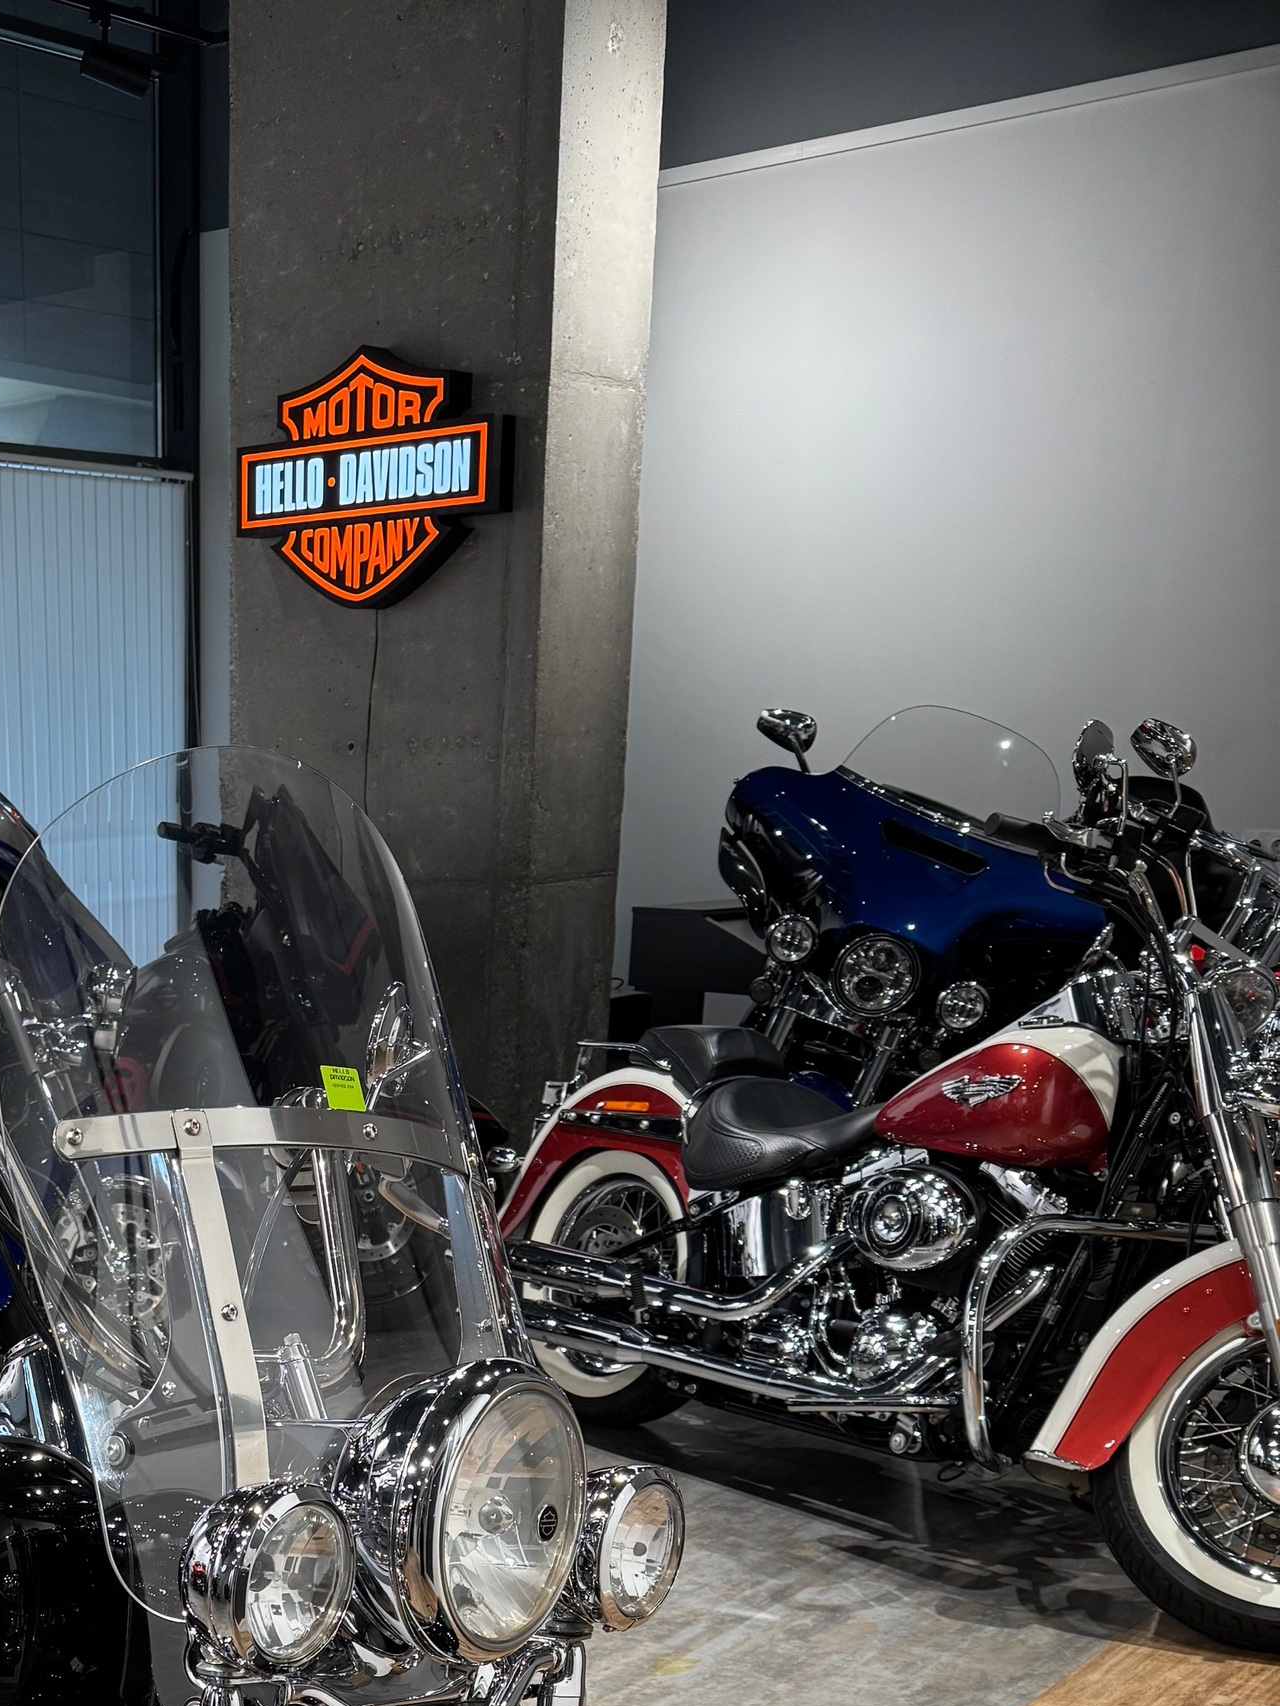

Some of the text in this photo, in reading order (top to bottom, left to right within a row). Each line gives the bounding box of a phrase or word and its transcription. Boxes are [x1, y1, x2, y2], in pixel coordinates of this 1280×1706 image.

[302, 372, 422, 440] MOTOR
[255, 438, 471, 515] HELLO DAVIDSON
[300, 516, 420, 589] COMPANY
